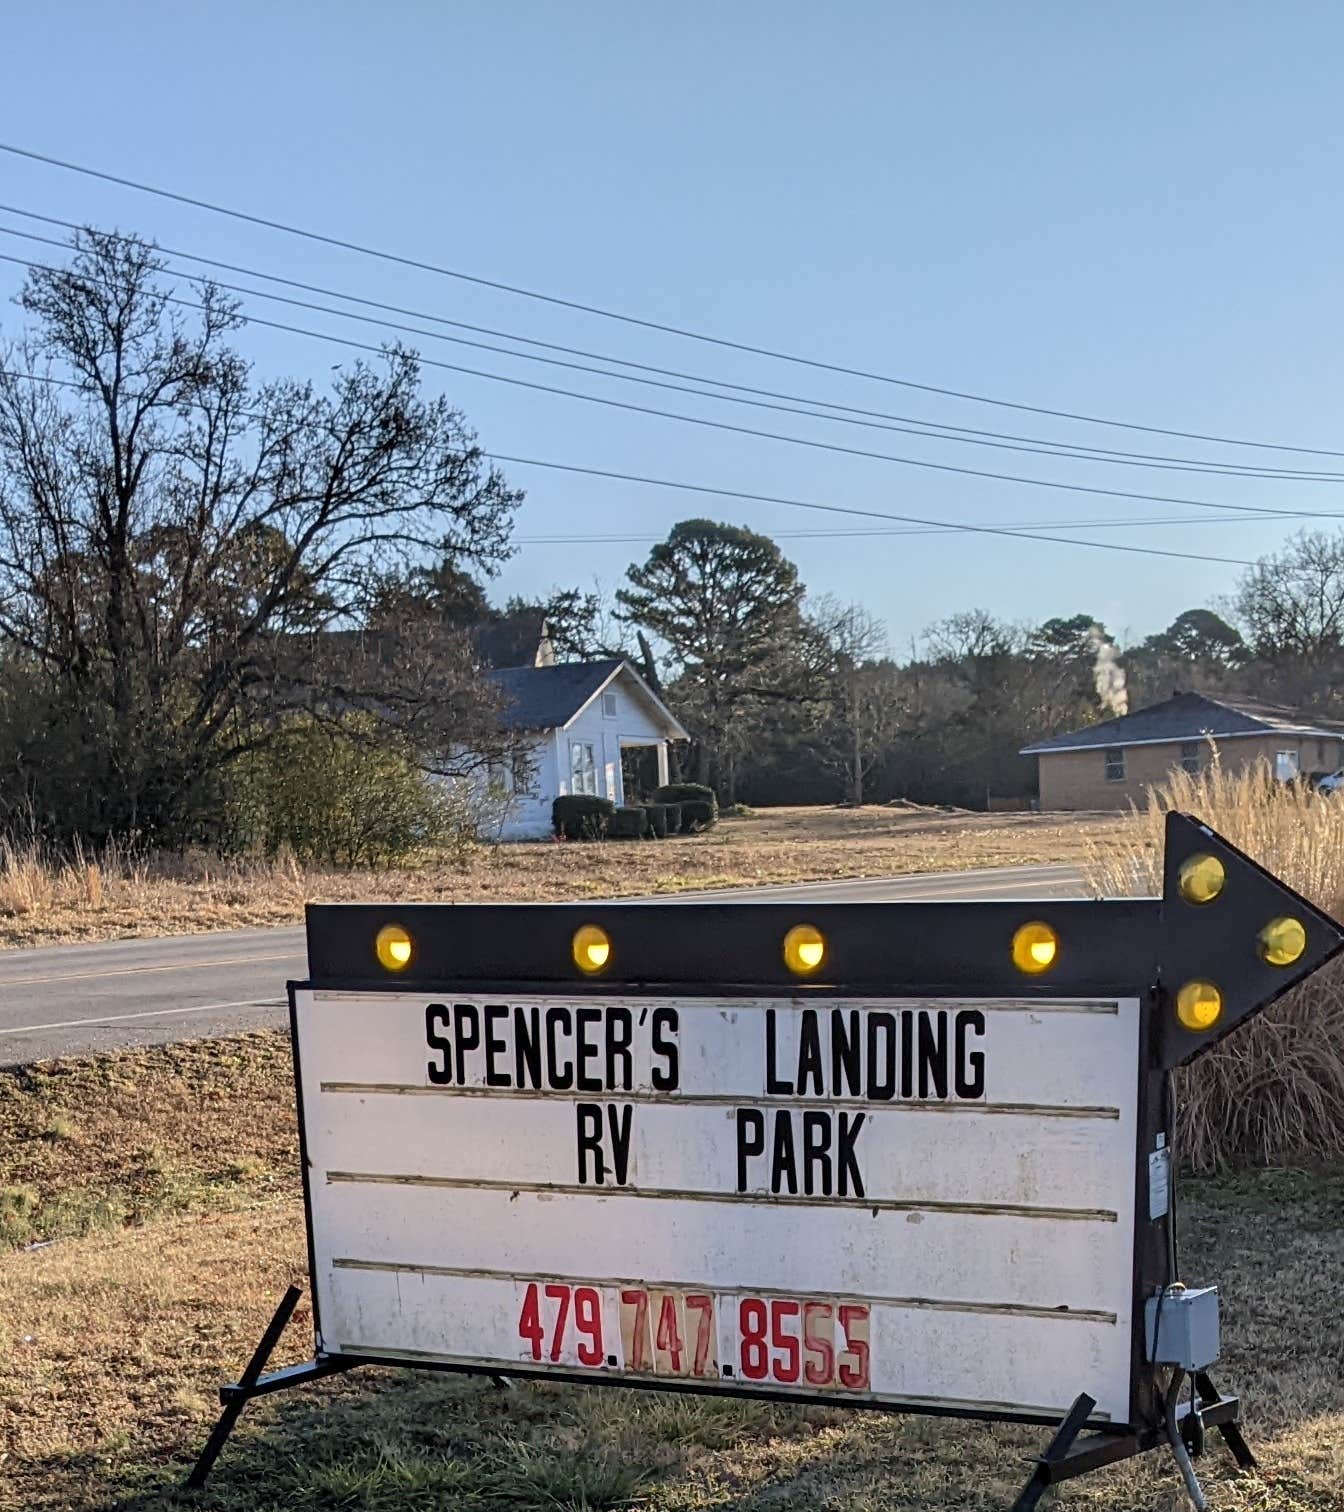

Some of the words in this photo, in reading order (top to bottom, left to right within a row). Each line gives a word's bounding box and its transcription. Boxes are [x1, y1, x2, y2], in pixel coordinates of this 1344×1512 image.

[425, 1003, 679, 1092] SPENCER'S
[766, 1008, 986, 1101] LANDING
[576, 1102, 633, 1186] RV
[736, 1107, 866, 1199] PARK
